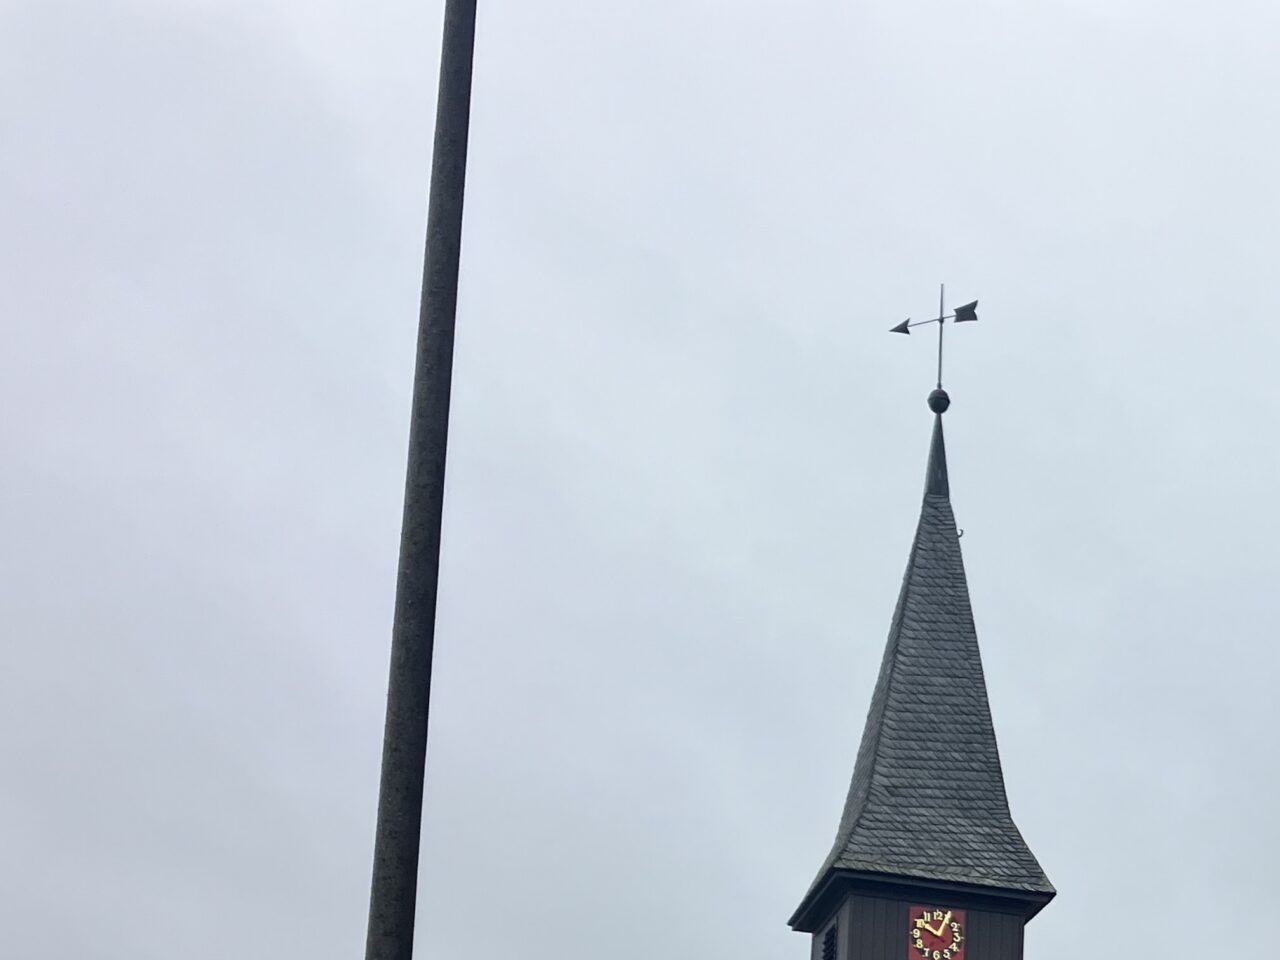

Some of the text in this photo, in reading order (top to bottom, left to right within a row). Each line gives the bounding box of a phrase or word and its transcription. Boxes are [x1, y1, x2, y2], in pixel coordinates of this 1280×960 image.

[923, 911, 931, 921] 11
[933, 910, 943, 920] 12
[950, 922, 959, 932] 2
[912, 928, 921, 938] 9
[953, 932, 961, 942] 3
[916, 938, 923, 948] 8
[949, 942, 958, 952] 4
[923, 948, 930, 957] 7
[933, 950, 940, 960] 6
[943, 949, 951, 959] 5
